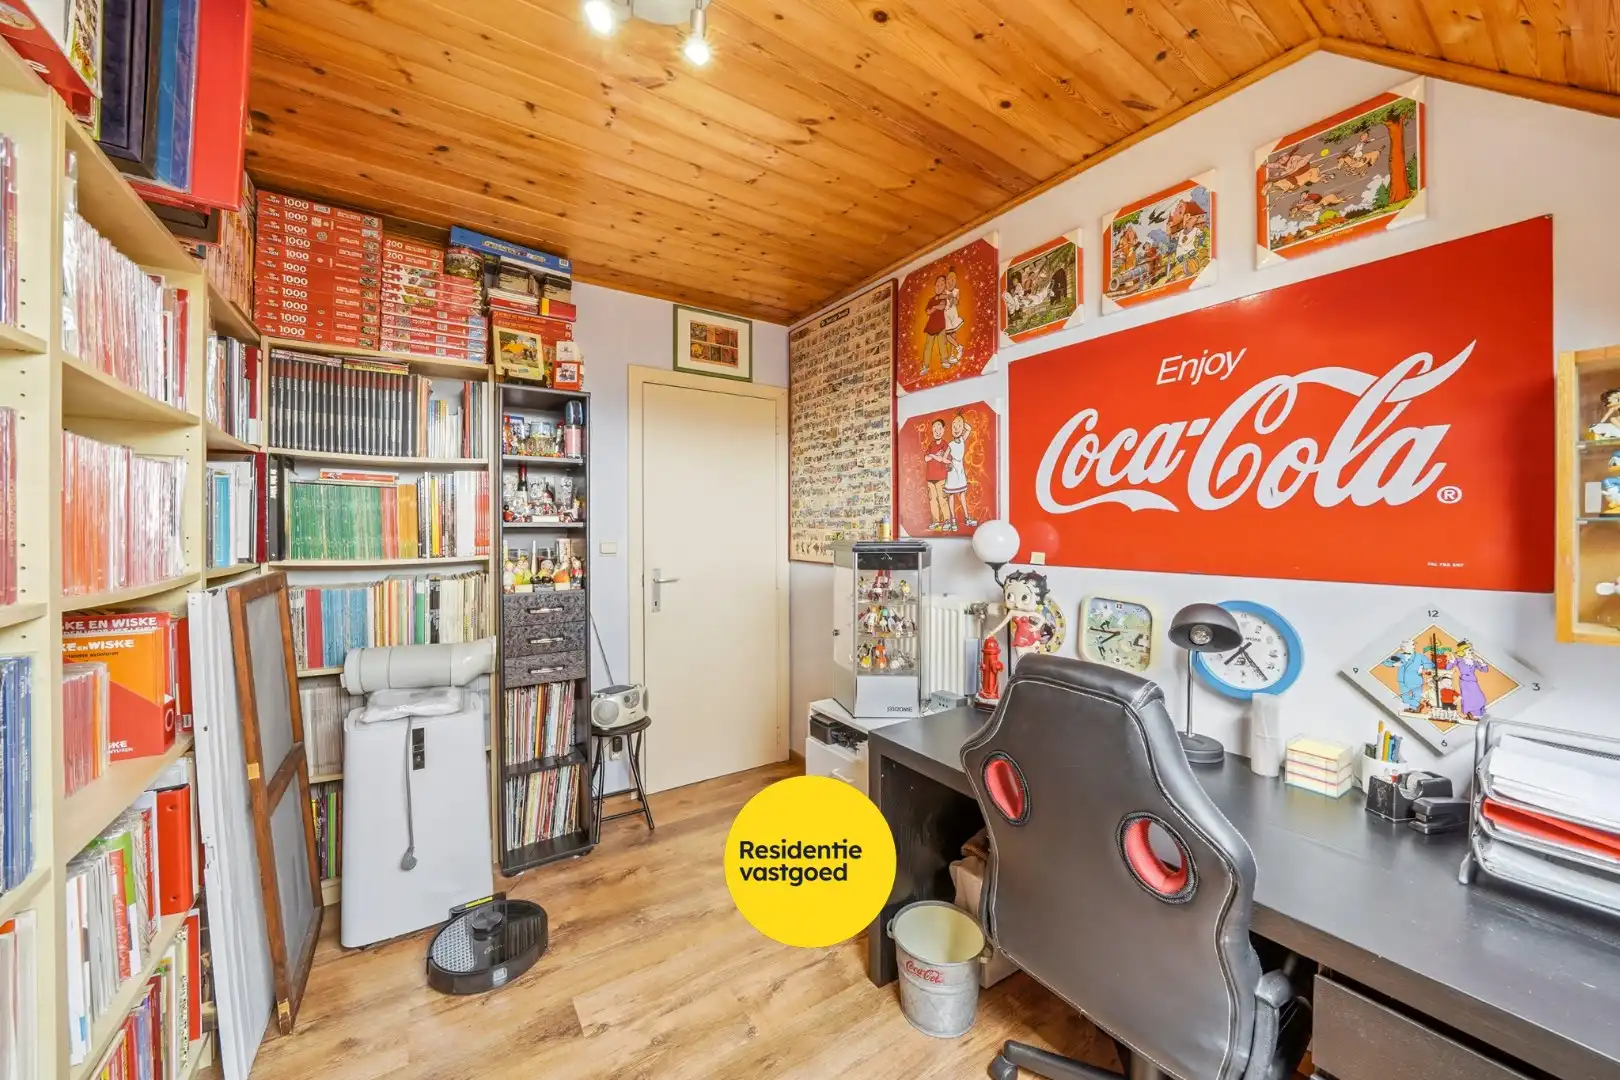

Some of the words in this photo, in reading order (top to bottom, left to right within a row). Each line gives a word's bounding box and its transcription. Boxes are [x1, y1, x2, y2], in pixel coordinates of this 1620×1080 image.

[283, 197, 309, 210] 1000
[284, 210, 308, 221] 1000
[284, 223, 307, 234] 1000
[284, 236, 310, 248] 1000
[386, 239, 403, 249] 200
[285, 249, 309, 260] 1000
[387, 251, 403, 261] 200
[283, 261, 307, 273] 1000
[282, 274, 308, 286] 1000
[282, 287, 308, 299] 1000
[282, 300, 308, 311] 1000
[280, 312, 307, 324] 1000
[279, 325, 305, 336] 1000
[1156, 346, 1247, 386] Enjoy
[1035, 339, 1477, 514] Coca-Cola
[1427, 609, 1440, 618] 12
[88, 619, 108, 629] EN
[111, 617, 158, 628] WISKE
[88, 639, 135, 650] WISKE
[1352, 667, 1359, 675] 9
[1532, 682, 1541, 691] 3
[1441, 739, 1448, 747] 6
